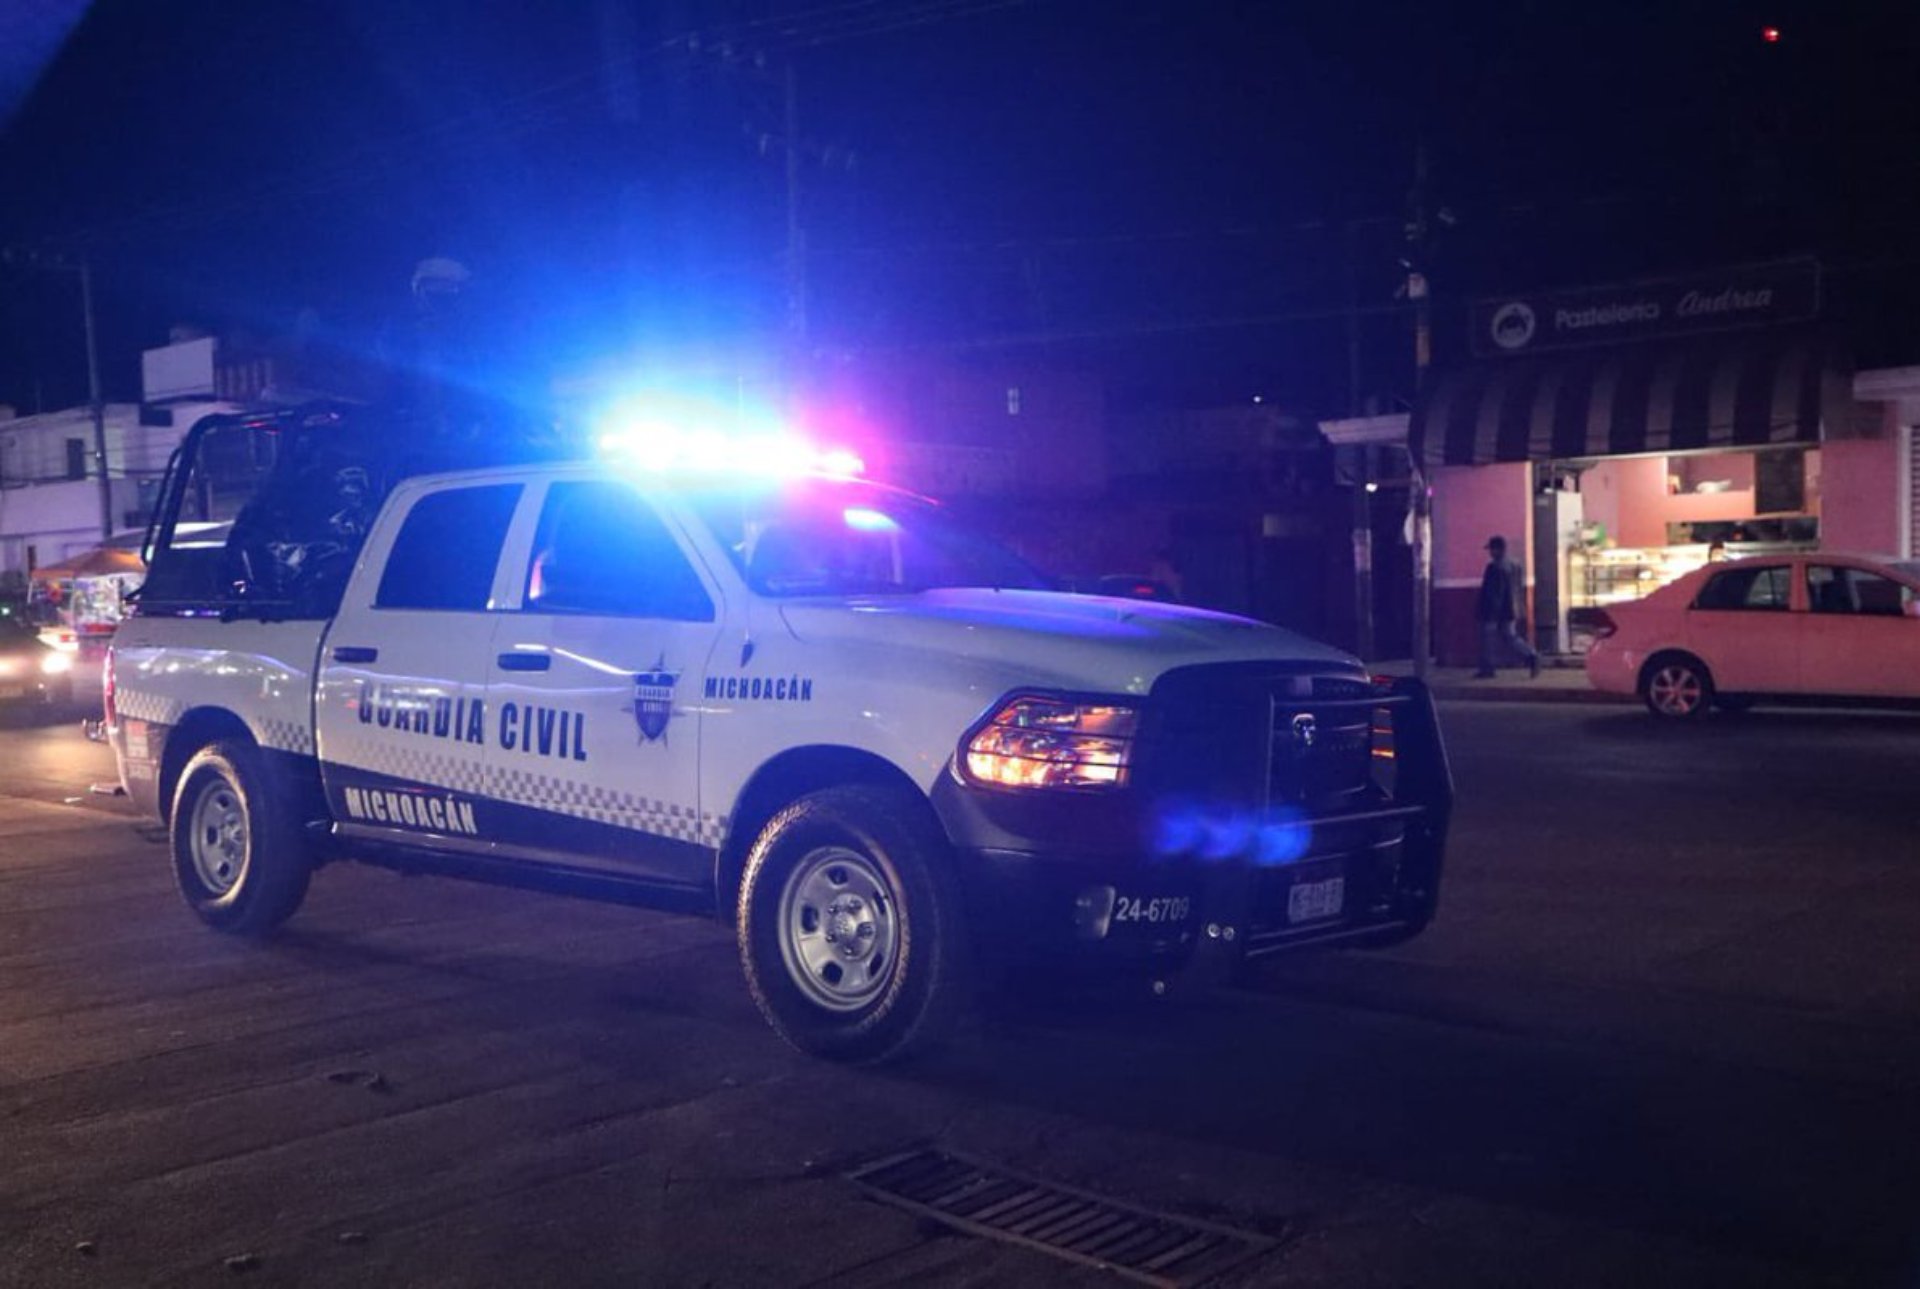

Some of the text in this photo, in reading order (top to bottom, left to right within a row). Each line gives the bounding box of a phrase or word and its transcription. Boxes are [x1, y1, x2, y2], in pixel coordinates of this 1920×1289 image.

[1675, 285, 1773, 317] Andrea
[704, 674, 812, 701] MICHOACÁN
[358, 677, 587, 761] GUARDIA CIVIL
[344, 786, 478, 835] MICHOACÁN
[1115, 896, 1190, 923] 24-6709
